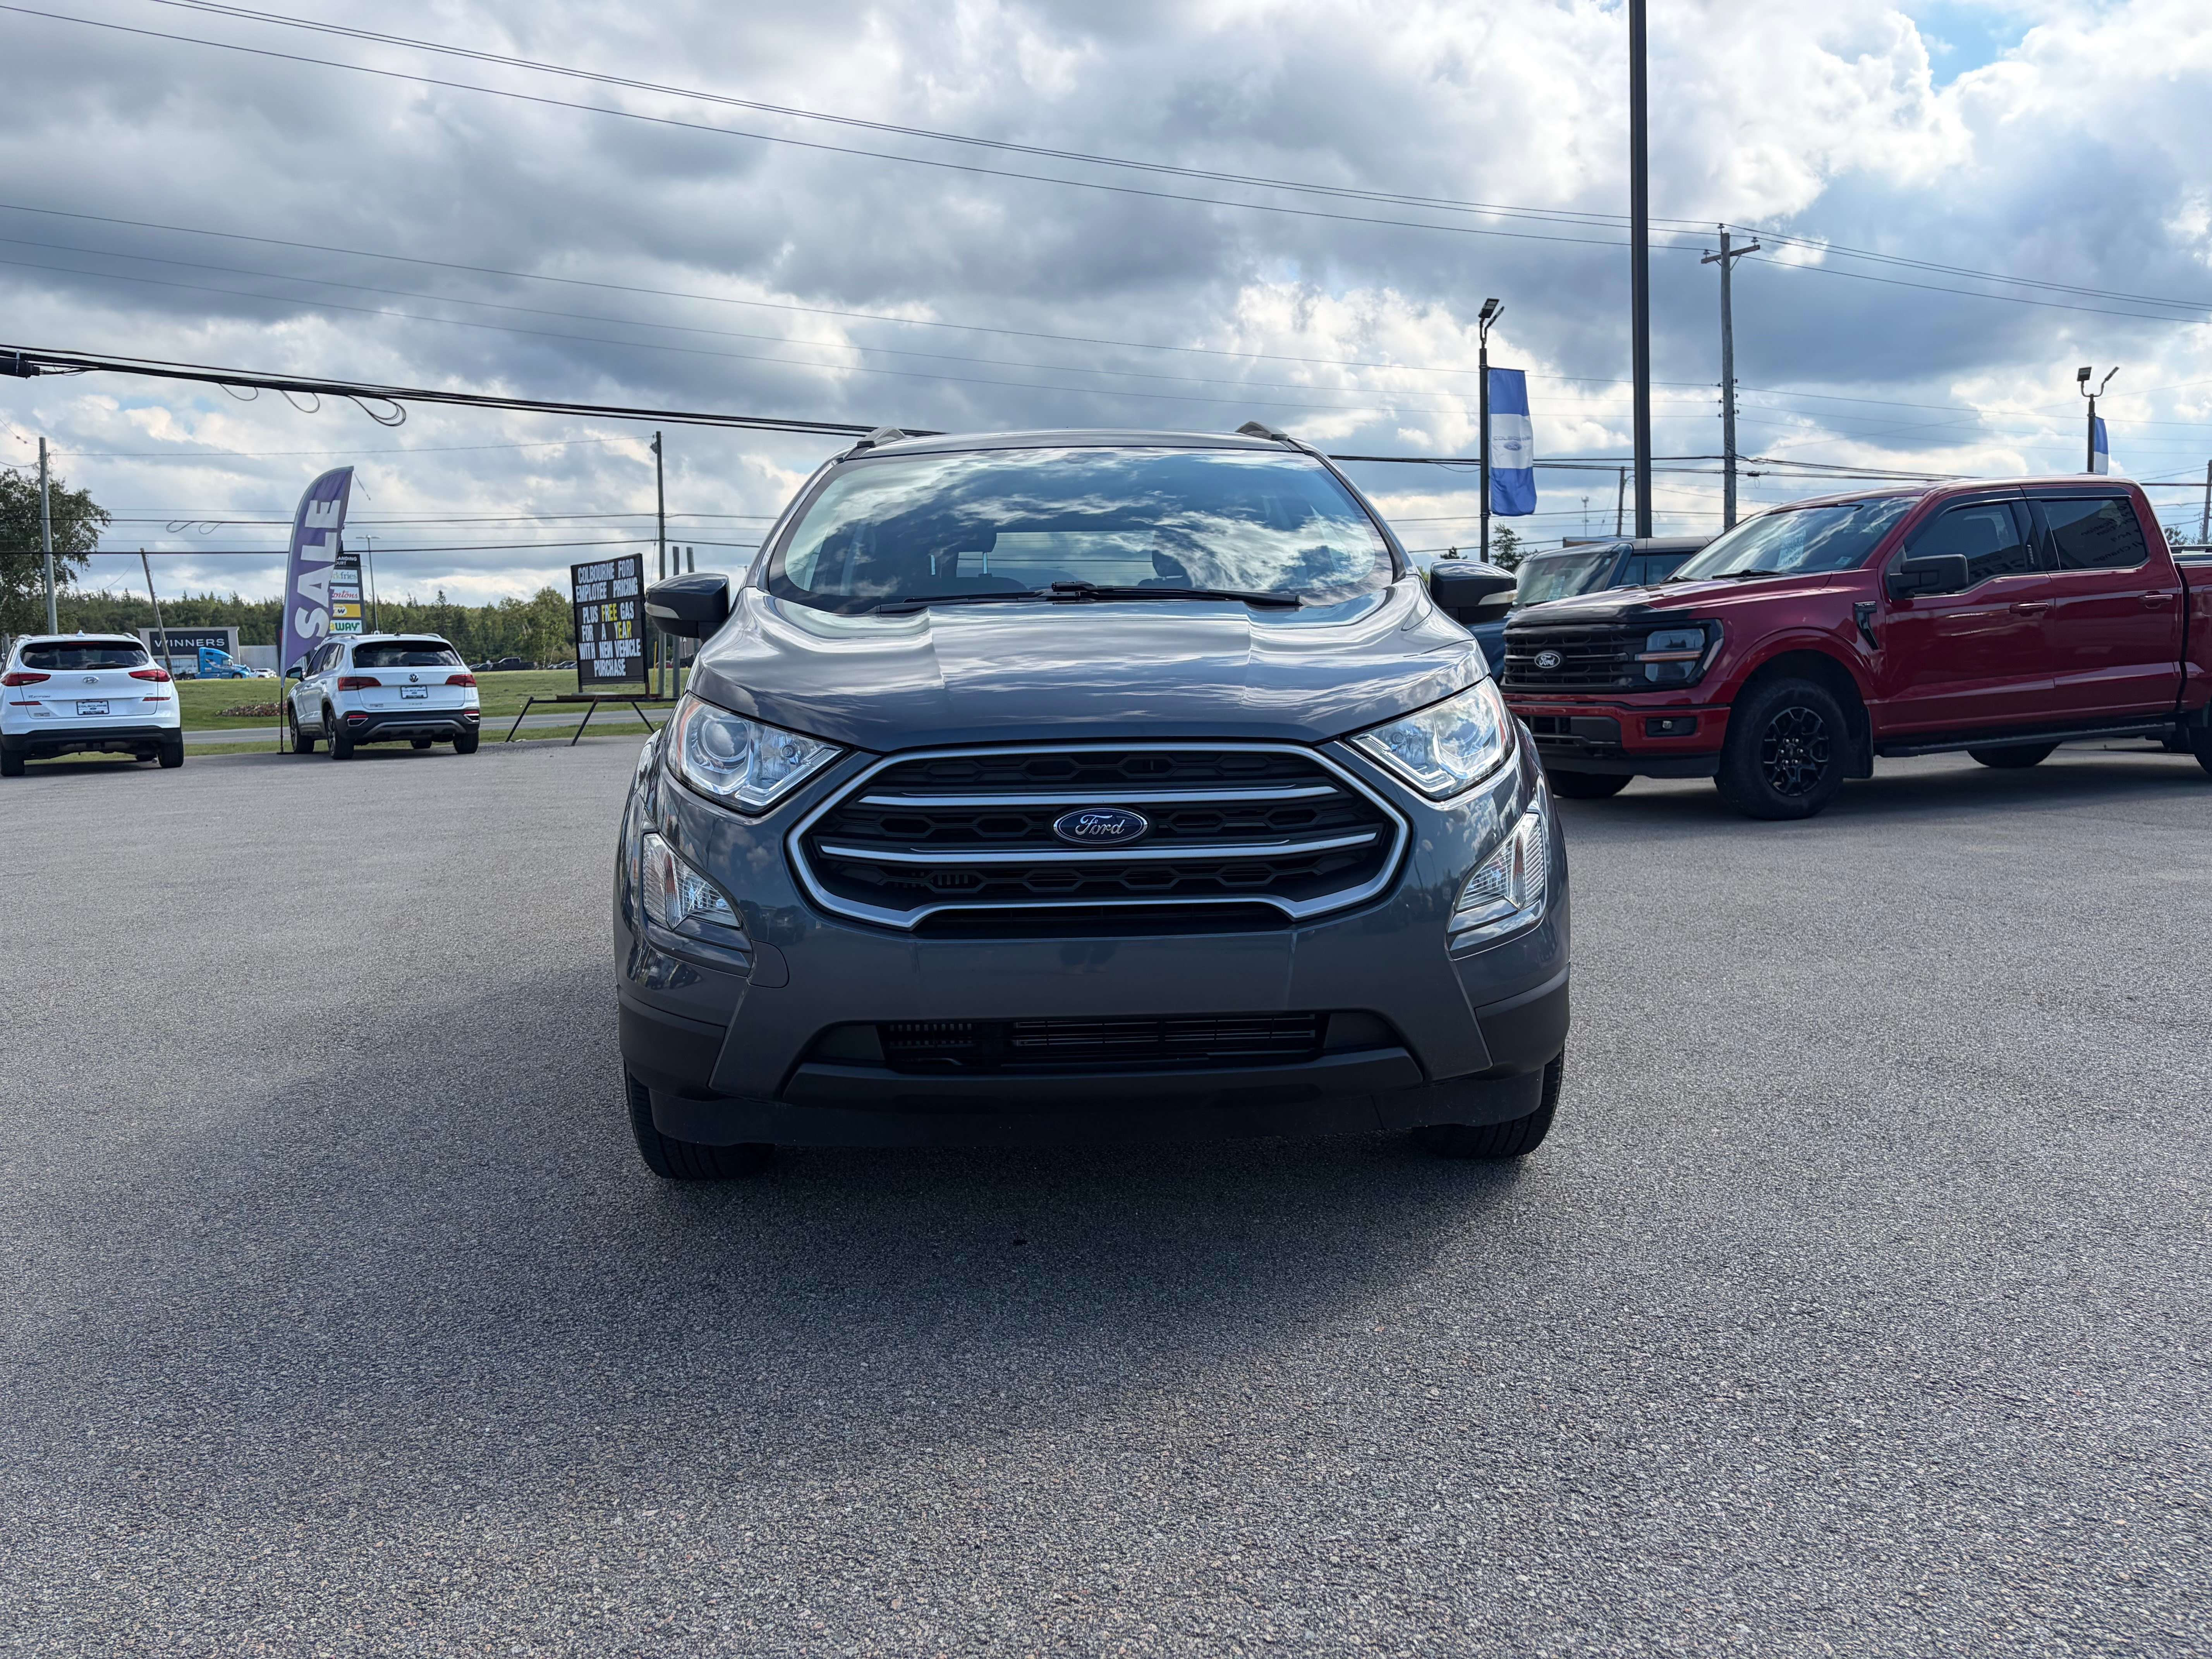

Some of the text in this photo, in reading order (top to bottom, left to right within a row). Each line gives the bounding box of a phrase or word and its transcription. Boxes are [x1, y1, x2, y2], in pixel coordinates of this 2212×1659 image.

[295, 500, 340, 639] SALE
[578, 558, 634, 584] COLBOURNE FORD
[575, 577, 638, 603] EMPLOYEE PRICING
[582, 601, 634, 624] PLUS FREE GAS
[582, 621, 632, 642] FOR A YEAR
[155, 639, 225, 647] WINNERS
[579, 639, 641, 660] WITH NEW VEHICLE
[594, 658, 626, 677] PURCHASE
[1539, 655, 1555, 666] Ford
[1075, 814, 1125, 835] Ford
